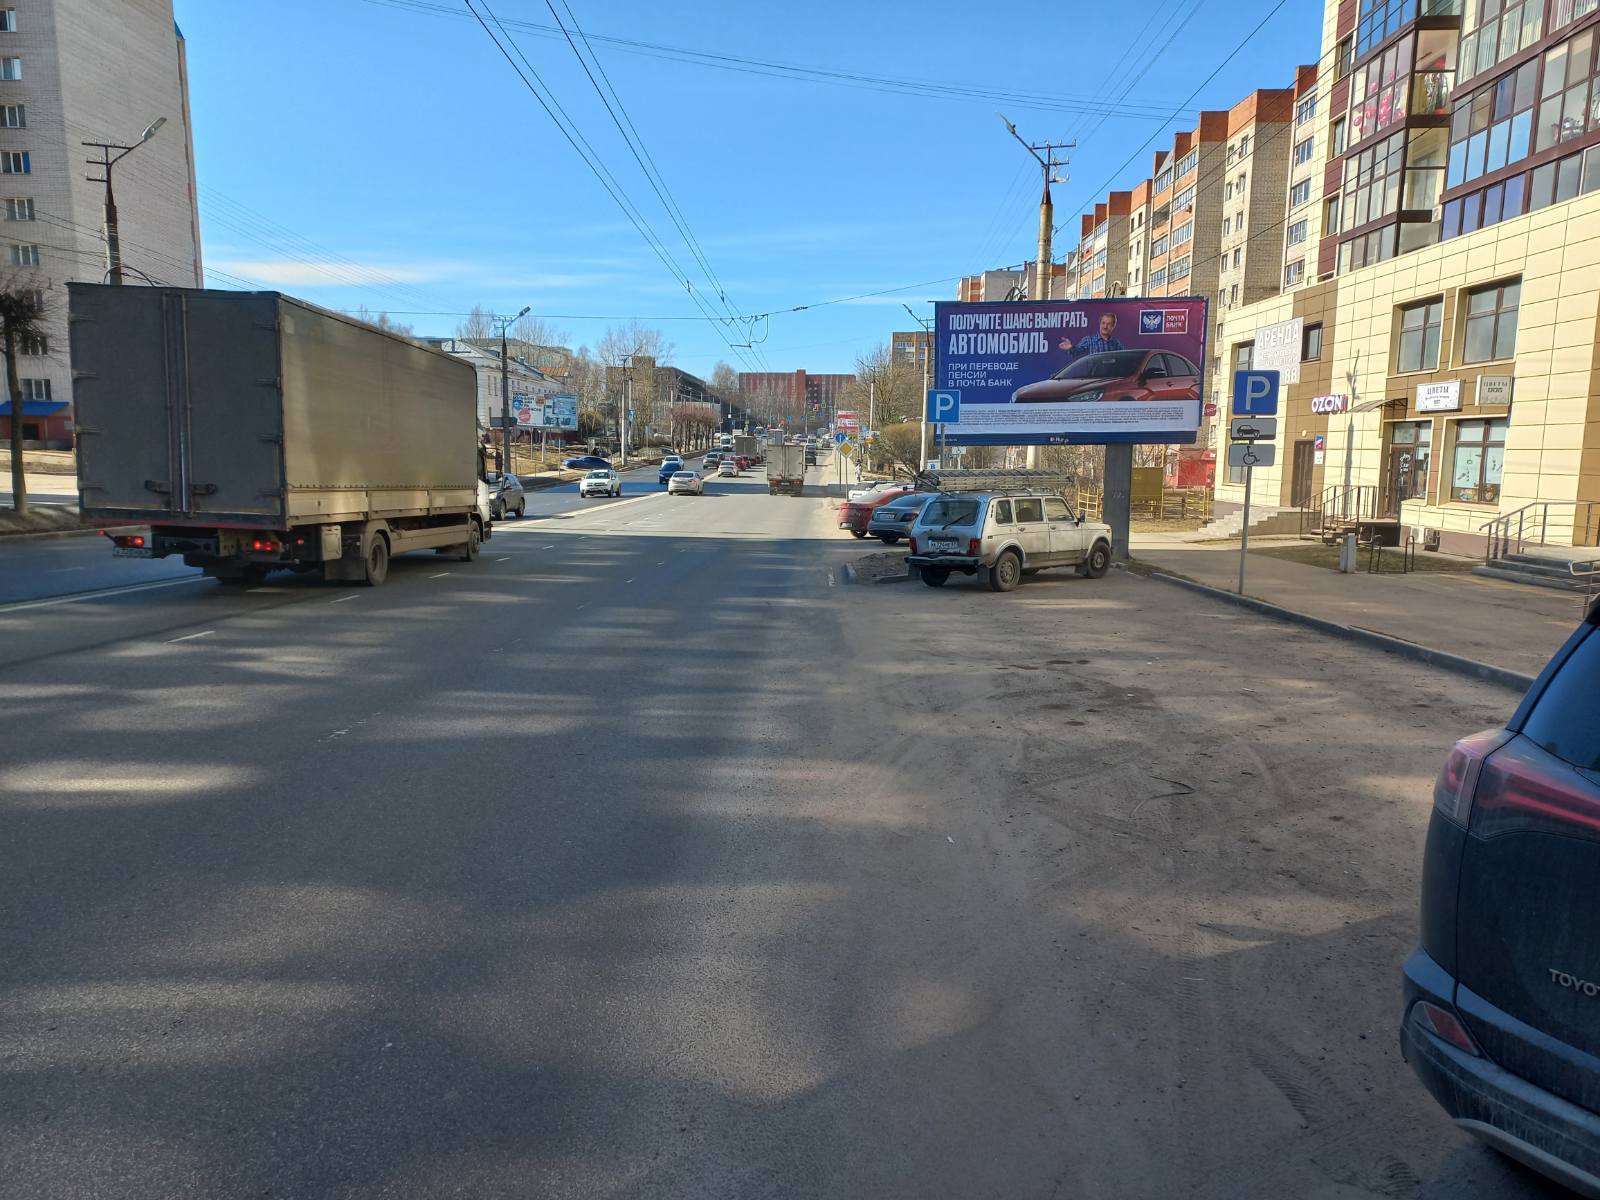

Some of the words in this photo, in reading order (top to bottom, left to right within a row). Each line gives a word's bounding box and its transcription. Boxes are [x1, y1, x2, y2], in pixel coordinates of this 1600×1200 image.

[949, 313, 1001, 330] ПОЛУЧИТЕ
[1002, 312, 1033, 329] ШАНС
[1034, 311, 1087, 329] ВЫИГРАТЬ
[948, 331, 1048, 355] АВТОМОБИЛЬ
[1257, 322, 1299, 350] АРЕНДА
[948, 363, 967, 371] ПРИ
[969, 362, 1019, 371] ПЕРЕВОДЕ
[948, 371, 987, 379] ПЕНСИИ
[948, 379, 955, 388] В
[956, 379, 986, 387] ПОЧТА
[987, 379, 1013, 387] БАНК
[1245, 375, 1271, 410] P
[935, 393, 954, 420] P
[1311, 394, 1343, 413] OZON
[1548, 968, 1600, 996] TOYO
